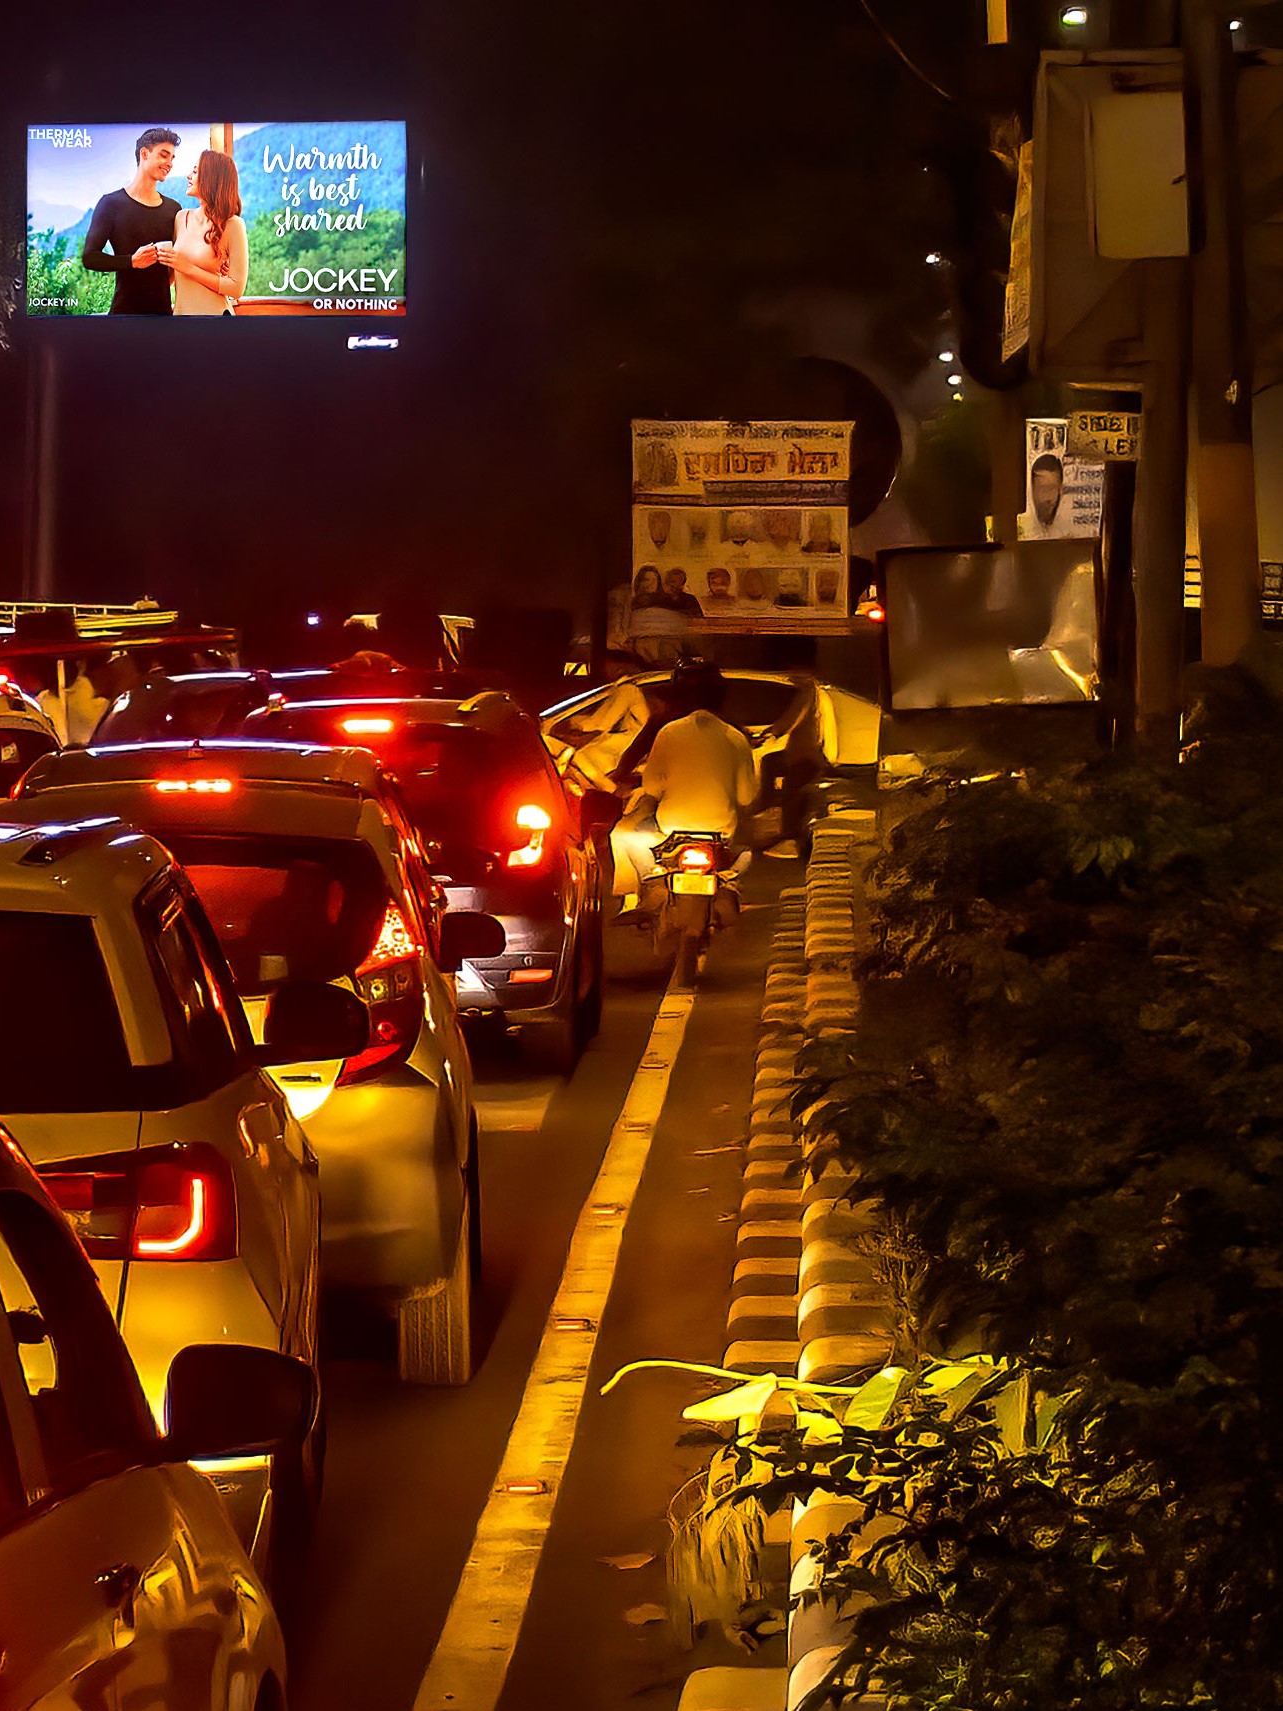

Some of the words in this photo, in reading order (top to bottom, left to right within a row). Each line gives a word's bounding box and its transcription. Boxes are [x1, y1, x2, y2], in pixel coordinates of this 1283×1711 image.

[28, 128, 90, 140] THERMAL
[52, 136, 93, 148] WEAR
[263, 142, 382, 173] Warmth
[281, 176, 304, 207] is
[309, 173, 361, 207] best
[273, 203, 368, 238] shared
[268, 267, 398, 293] JOCKEY
[28, 297, 79, 307] JOCKEY.IN
[313, 298, 333, 310] OR
[335, 299, 398, 310] NOTHING
